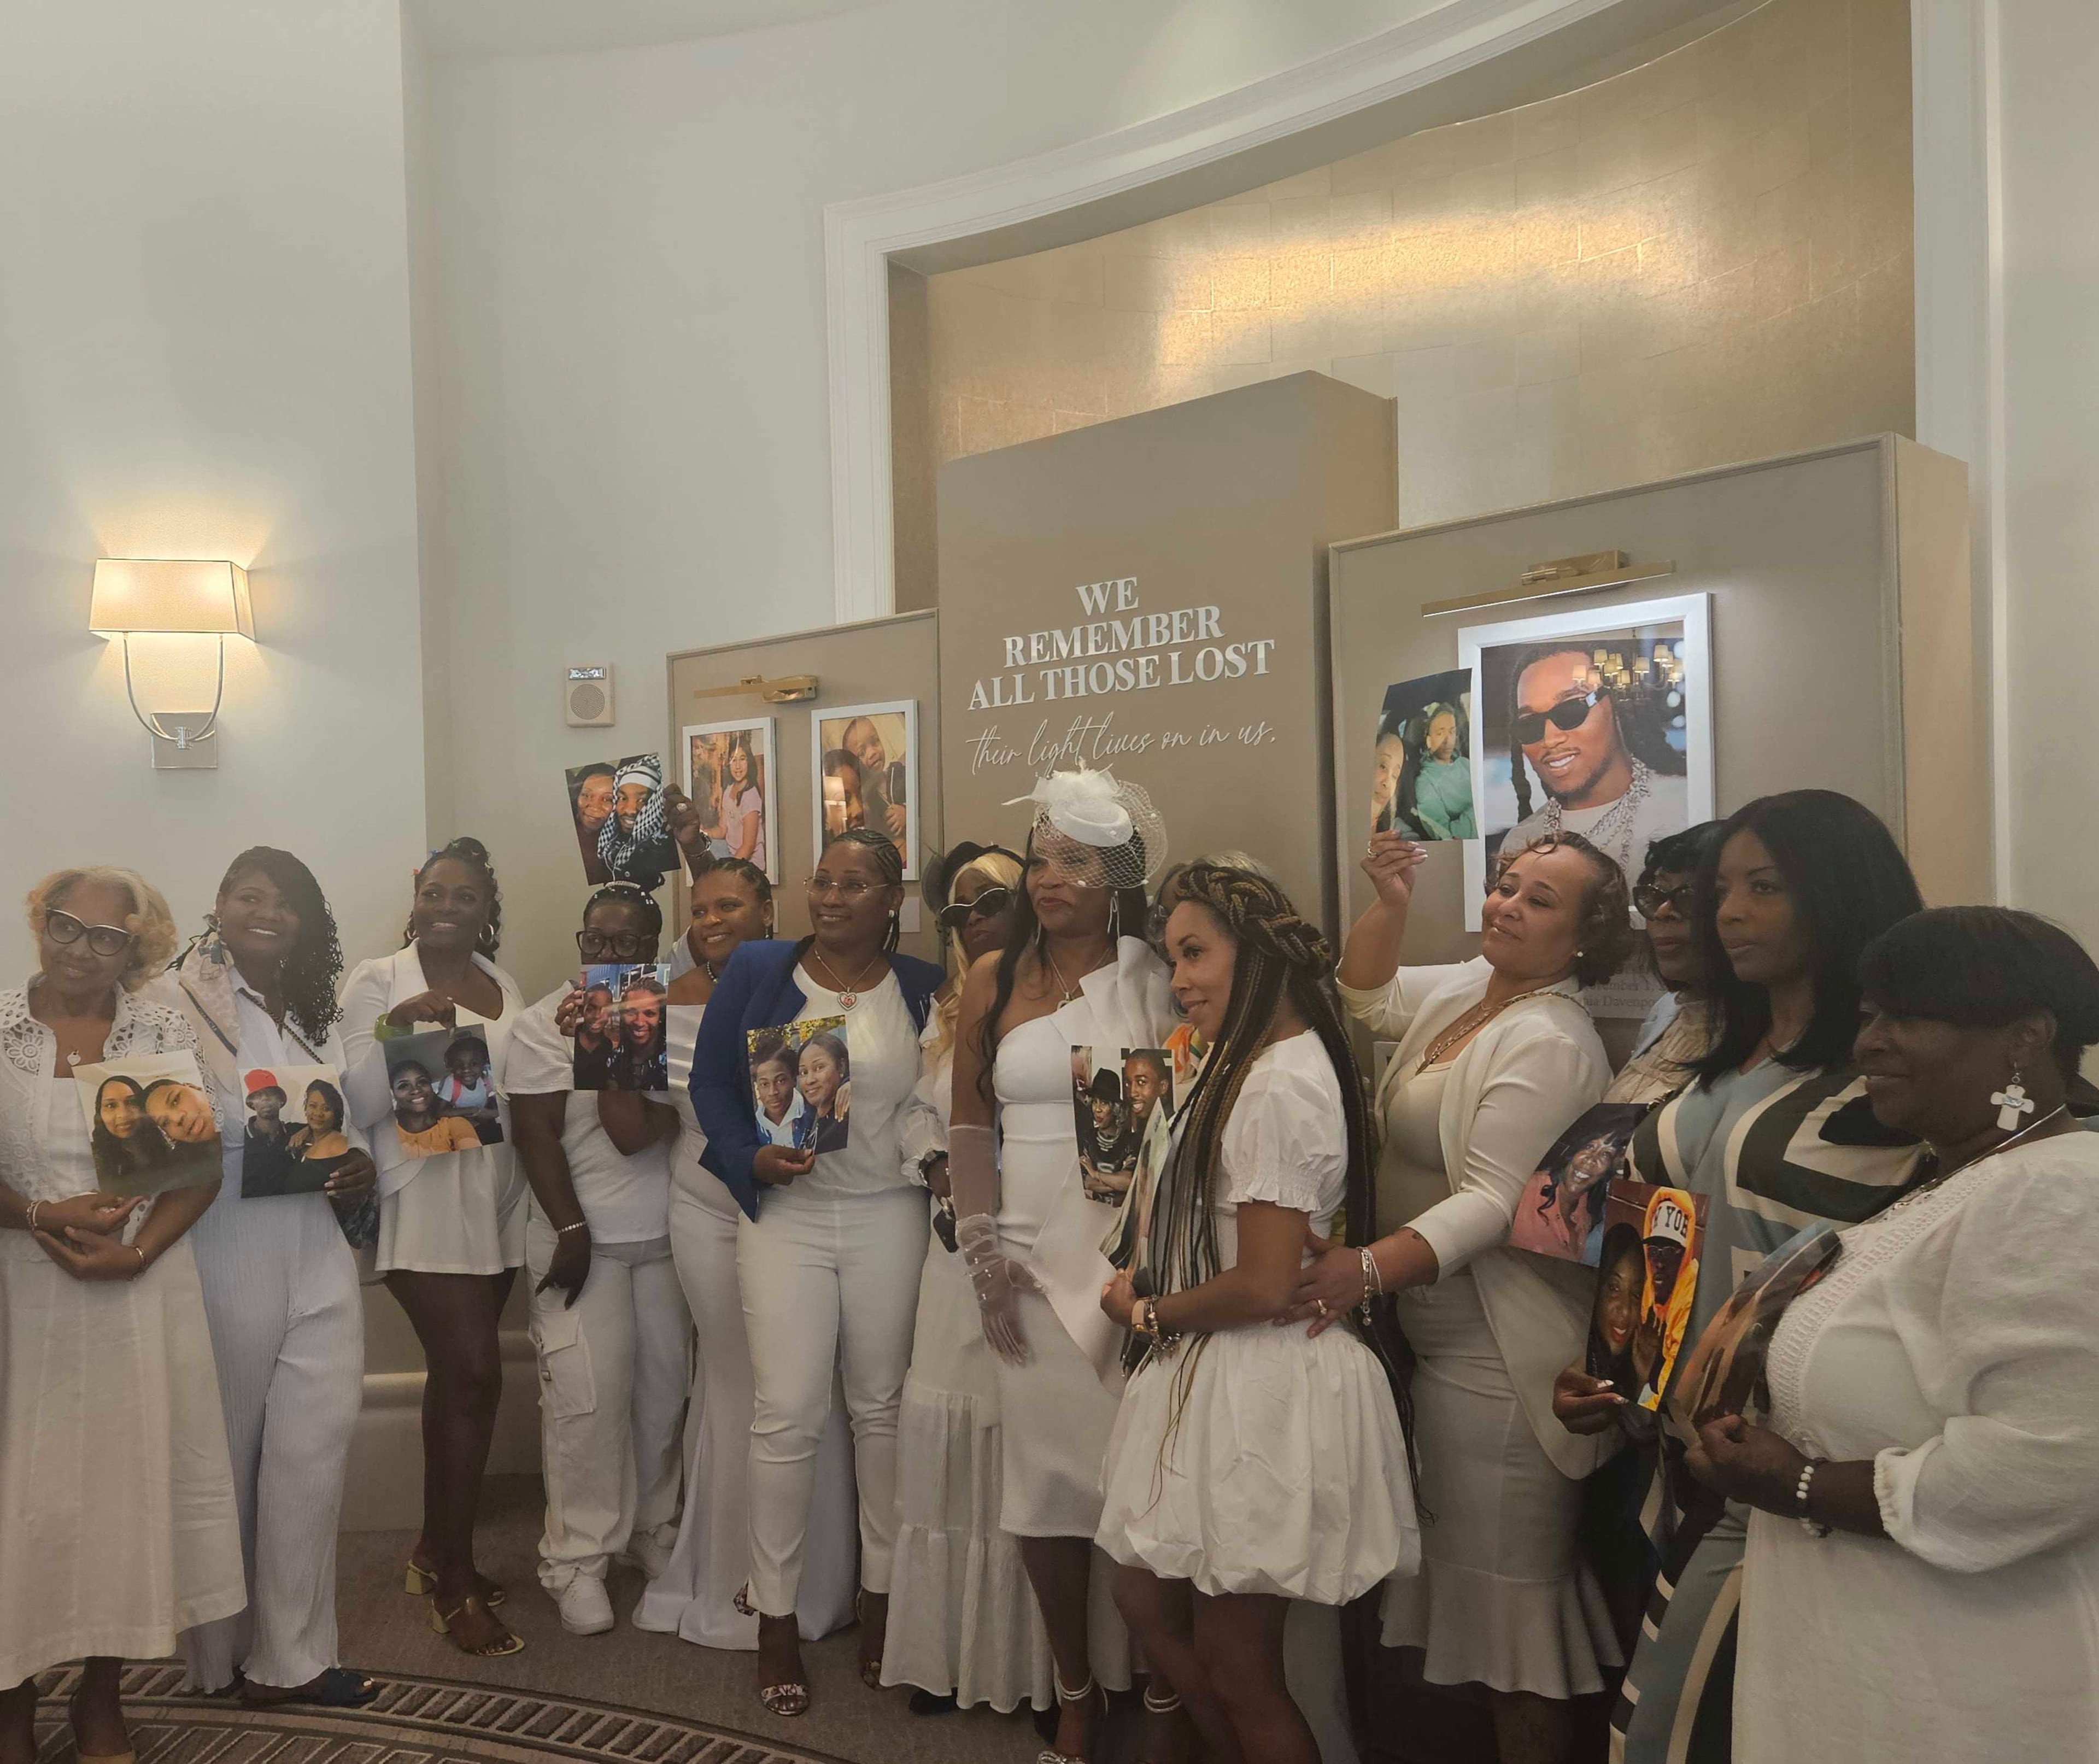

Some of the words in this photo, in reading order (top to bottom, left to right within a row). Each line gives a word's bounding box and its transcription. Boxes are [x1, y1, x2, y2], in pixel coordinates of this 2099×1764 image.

[1076, 576, 1139, 616] WE
[1003, 605, 1225, 667] REMEMBER
[967, 673, 1035, 711] ALL
[1040, 655, 1160, 700] THOSE
[1167, 639, 1275, 685] LOST
[966, 725, 1022, 775] their
[1028, 716, 1099, 777] light
[1093, 711, 1155, 760] lives
[1161, 732, 1192, 749] on
[1200, 724, 1230, 746] in
[1603, 995, 1655, 1010] Davenpo
